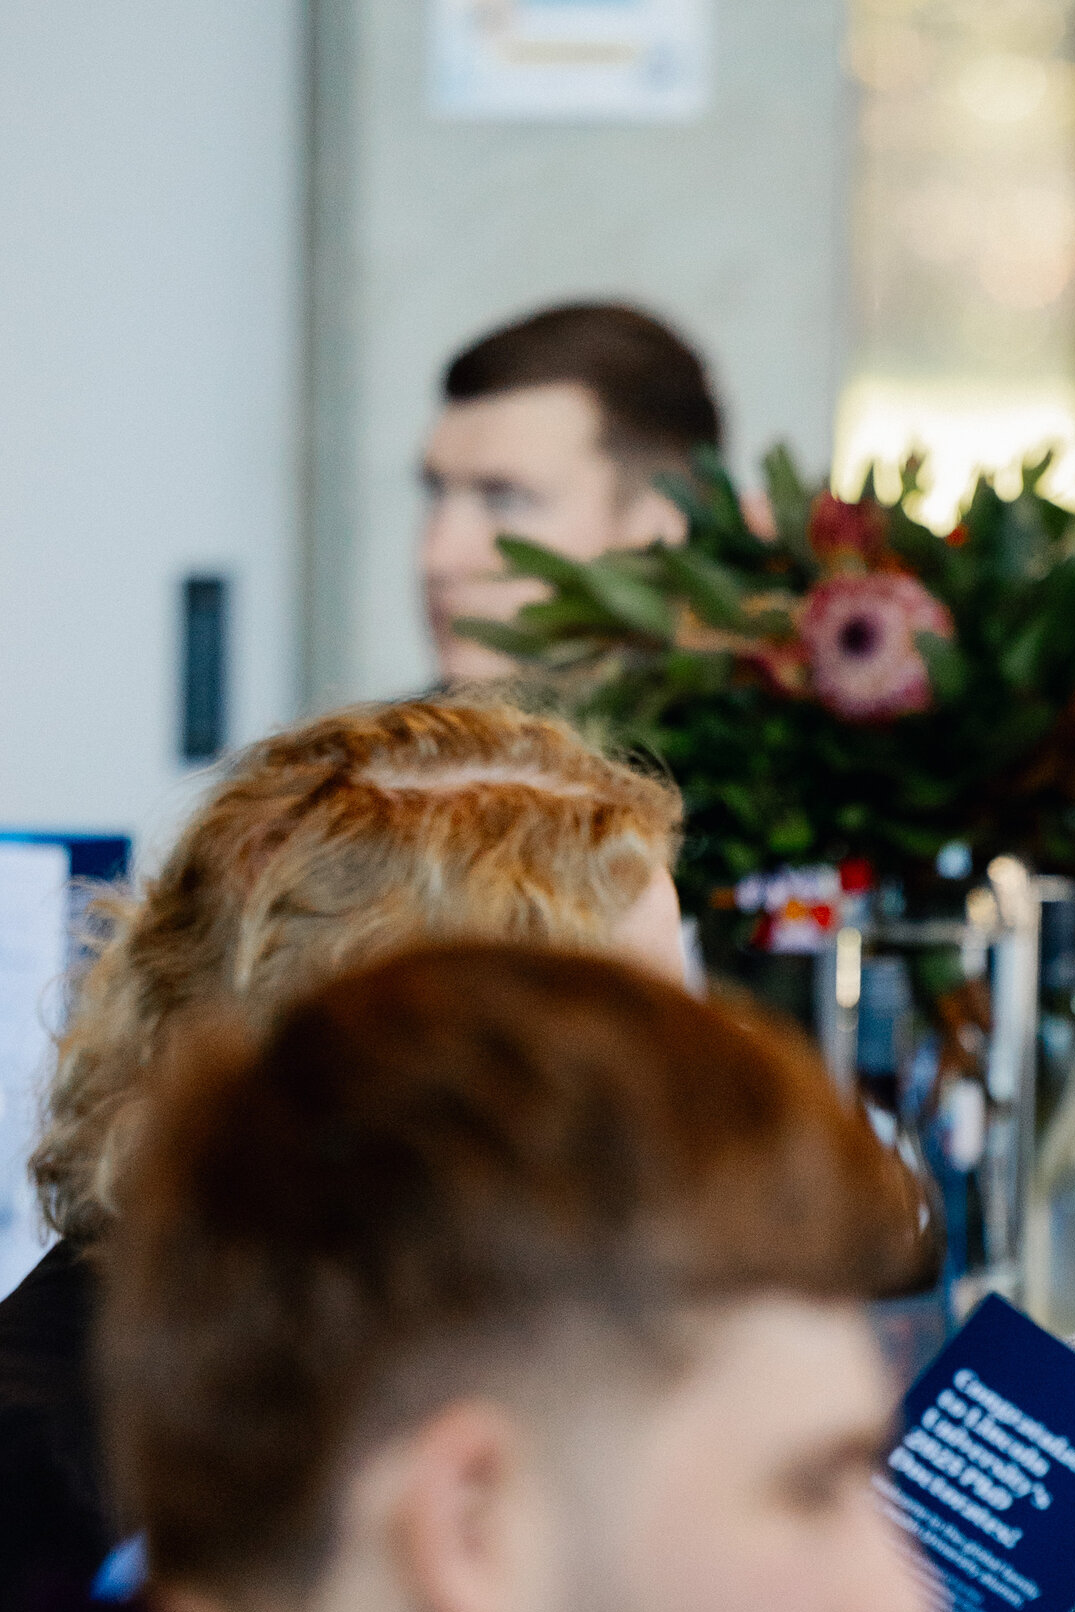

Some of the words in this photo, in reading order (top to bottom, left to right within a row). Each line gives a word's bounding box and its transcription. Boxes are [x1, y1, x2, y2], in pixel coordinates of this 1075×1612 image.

[935, 1386, 970, 1420] to
[962, 1405, 1053, 1479] Lincoln
[957, 1463, 1015, 1513] PhD
